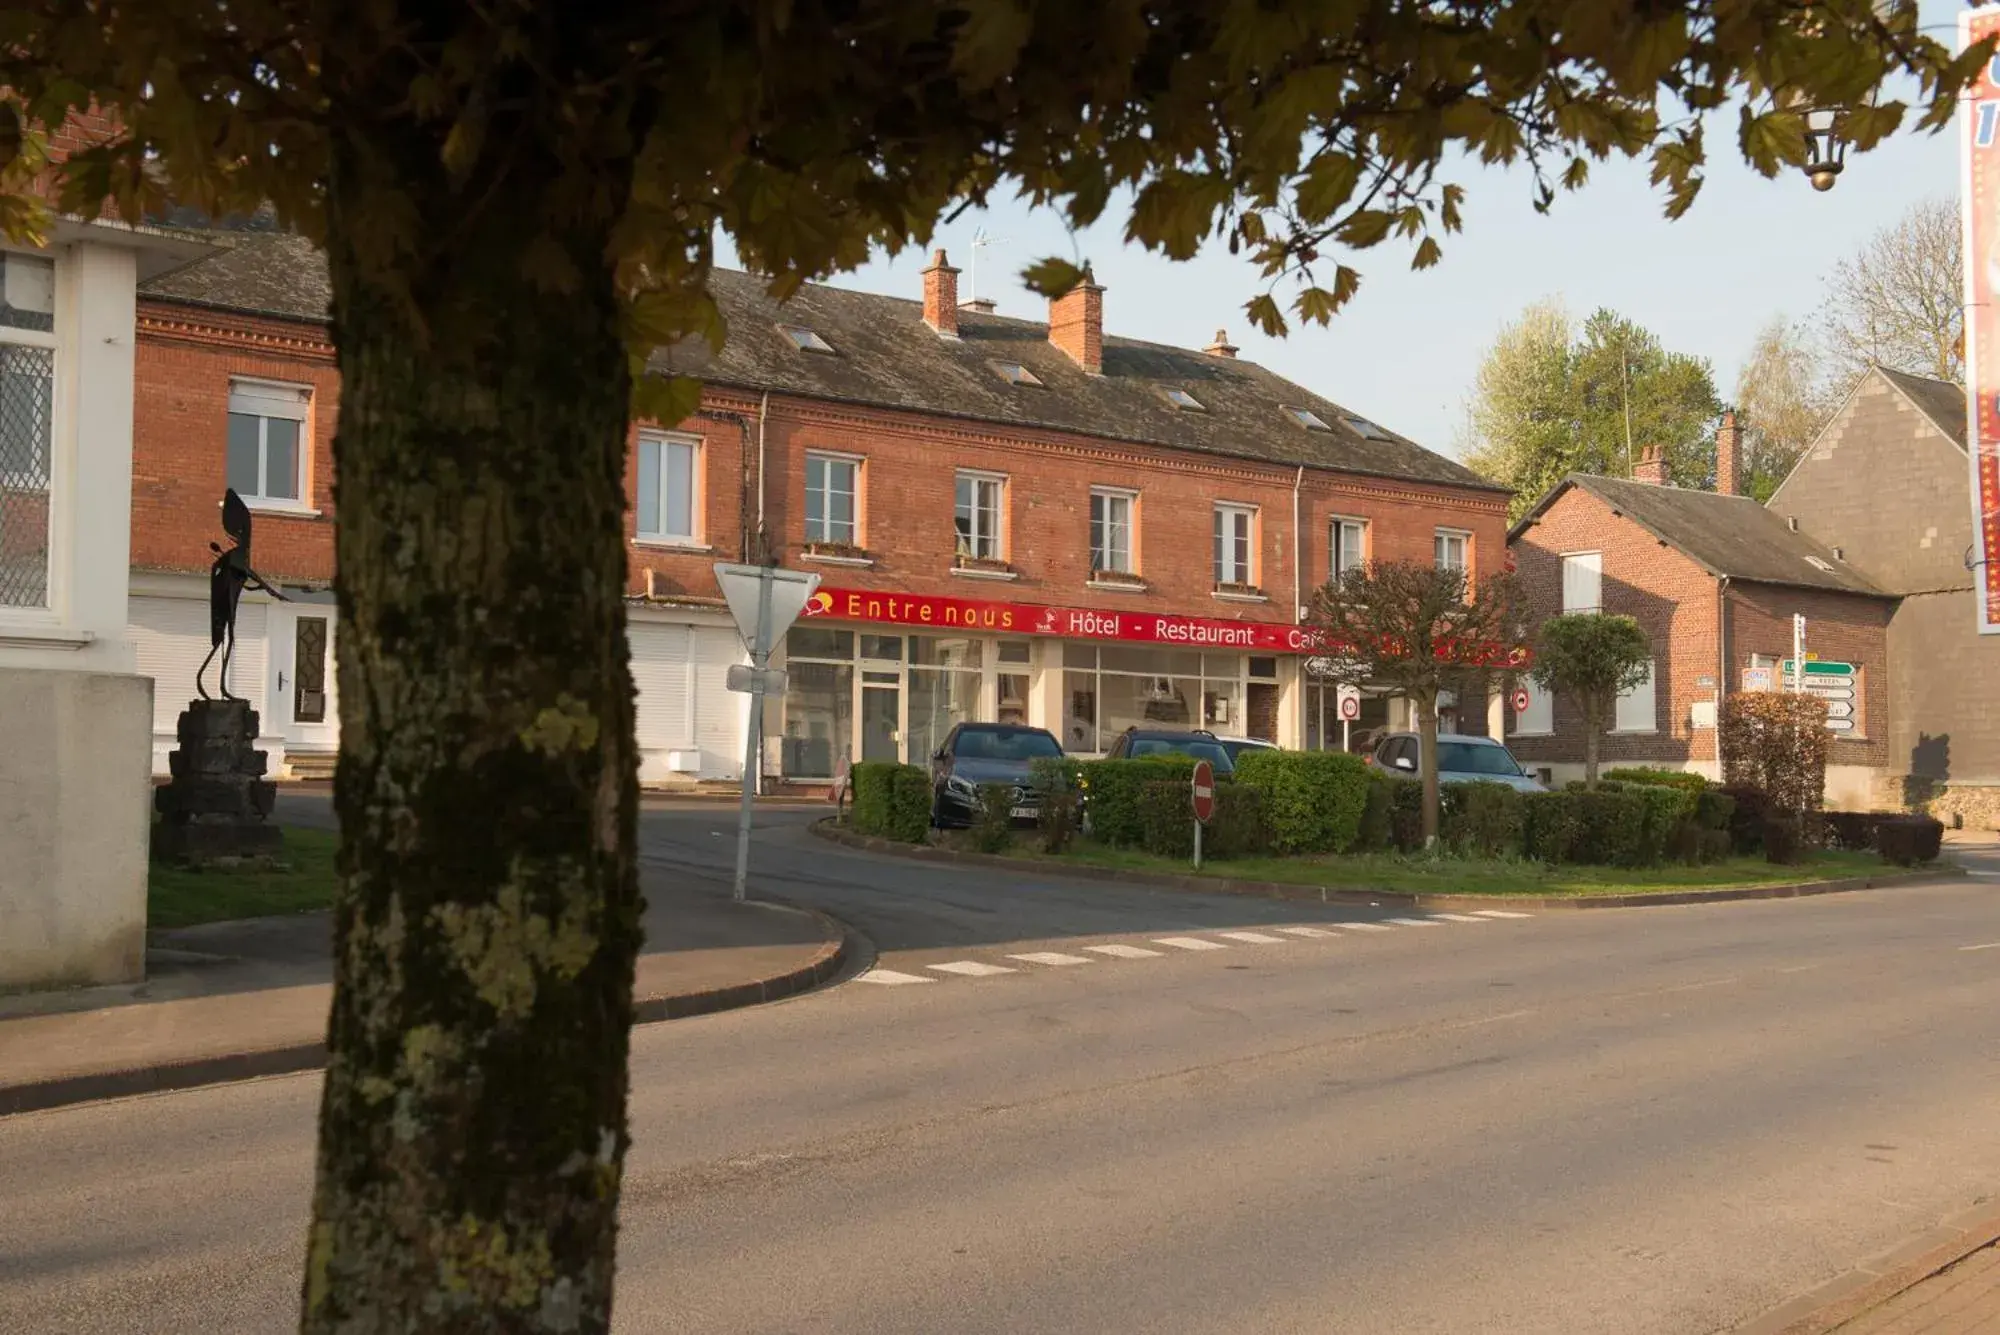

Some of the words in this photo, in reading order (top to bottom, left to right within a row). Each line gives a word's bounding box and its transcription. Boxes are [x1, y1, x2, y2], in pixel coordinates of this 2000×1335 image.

[848, 594, 932, 621] Entre
[945, 606, 1013, 627] nous
[1069, 611, 1120, 635] Hôtel
[1155, 619, 1255, 645] Restaurant
